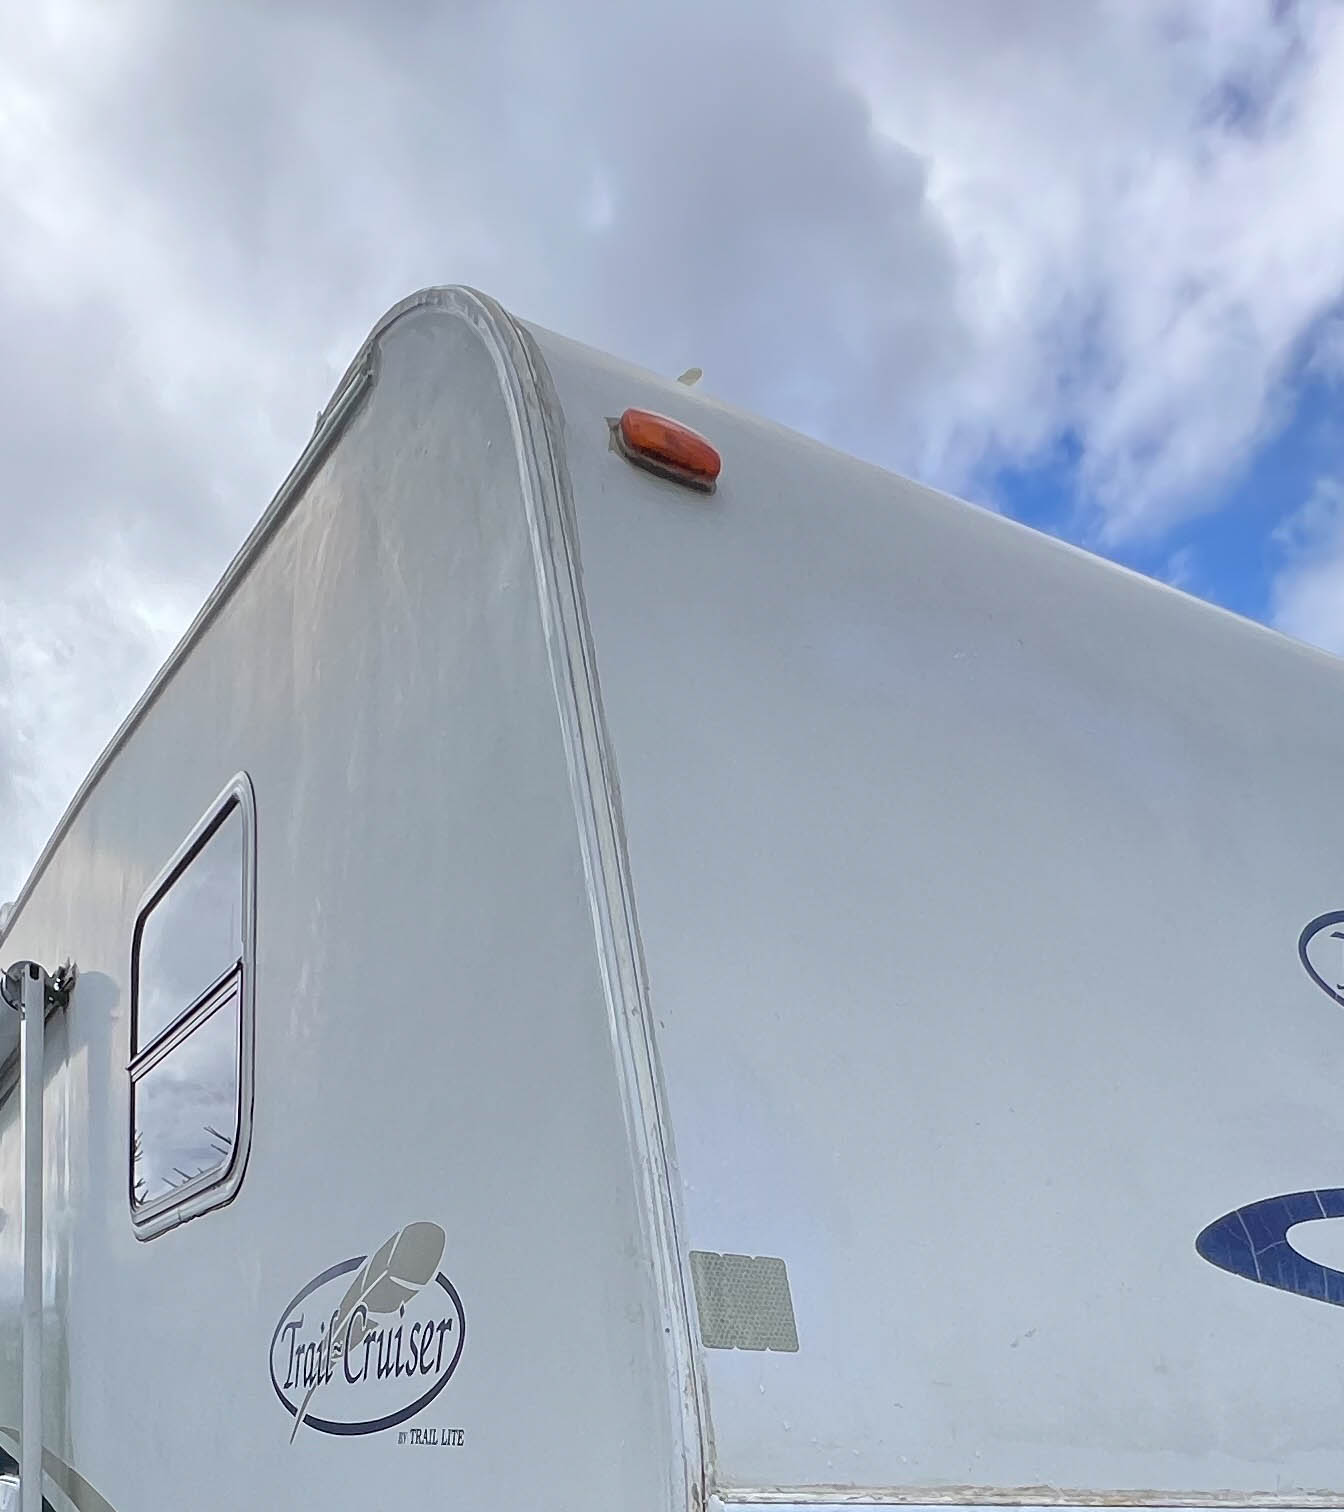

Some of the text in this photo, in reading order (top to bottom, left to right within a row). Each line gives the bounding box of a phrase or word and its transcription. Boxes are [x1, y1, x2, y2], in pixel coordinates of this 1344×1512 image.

[280, 1303, 453, 1389] Trail-Cruiser
[410, 1428, 438, 1446] TRAIL
[440, 1428, 464, 1446] LITE
